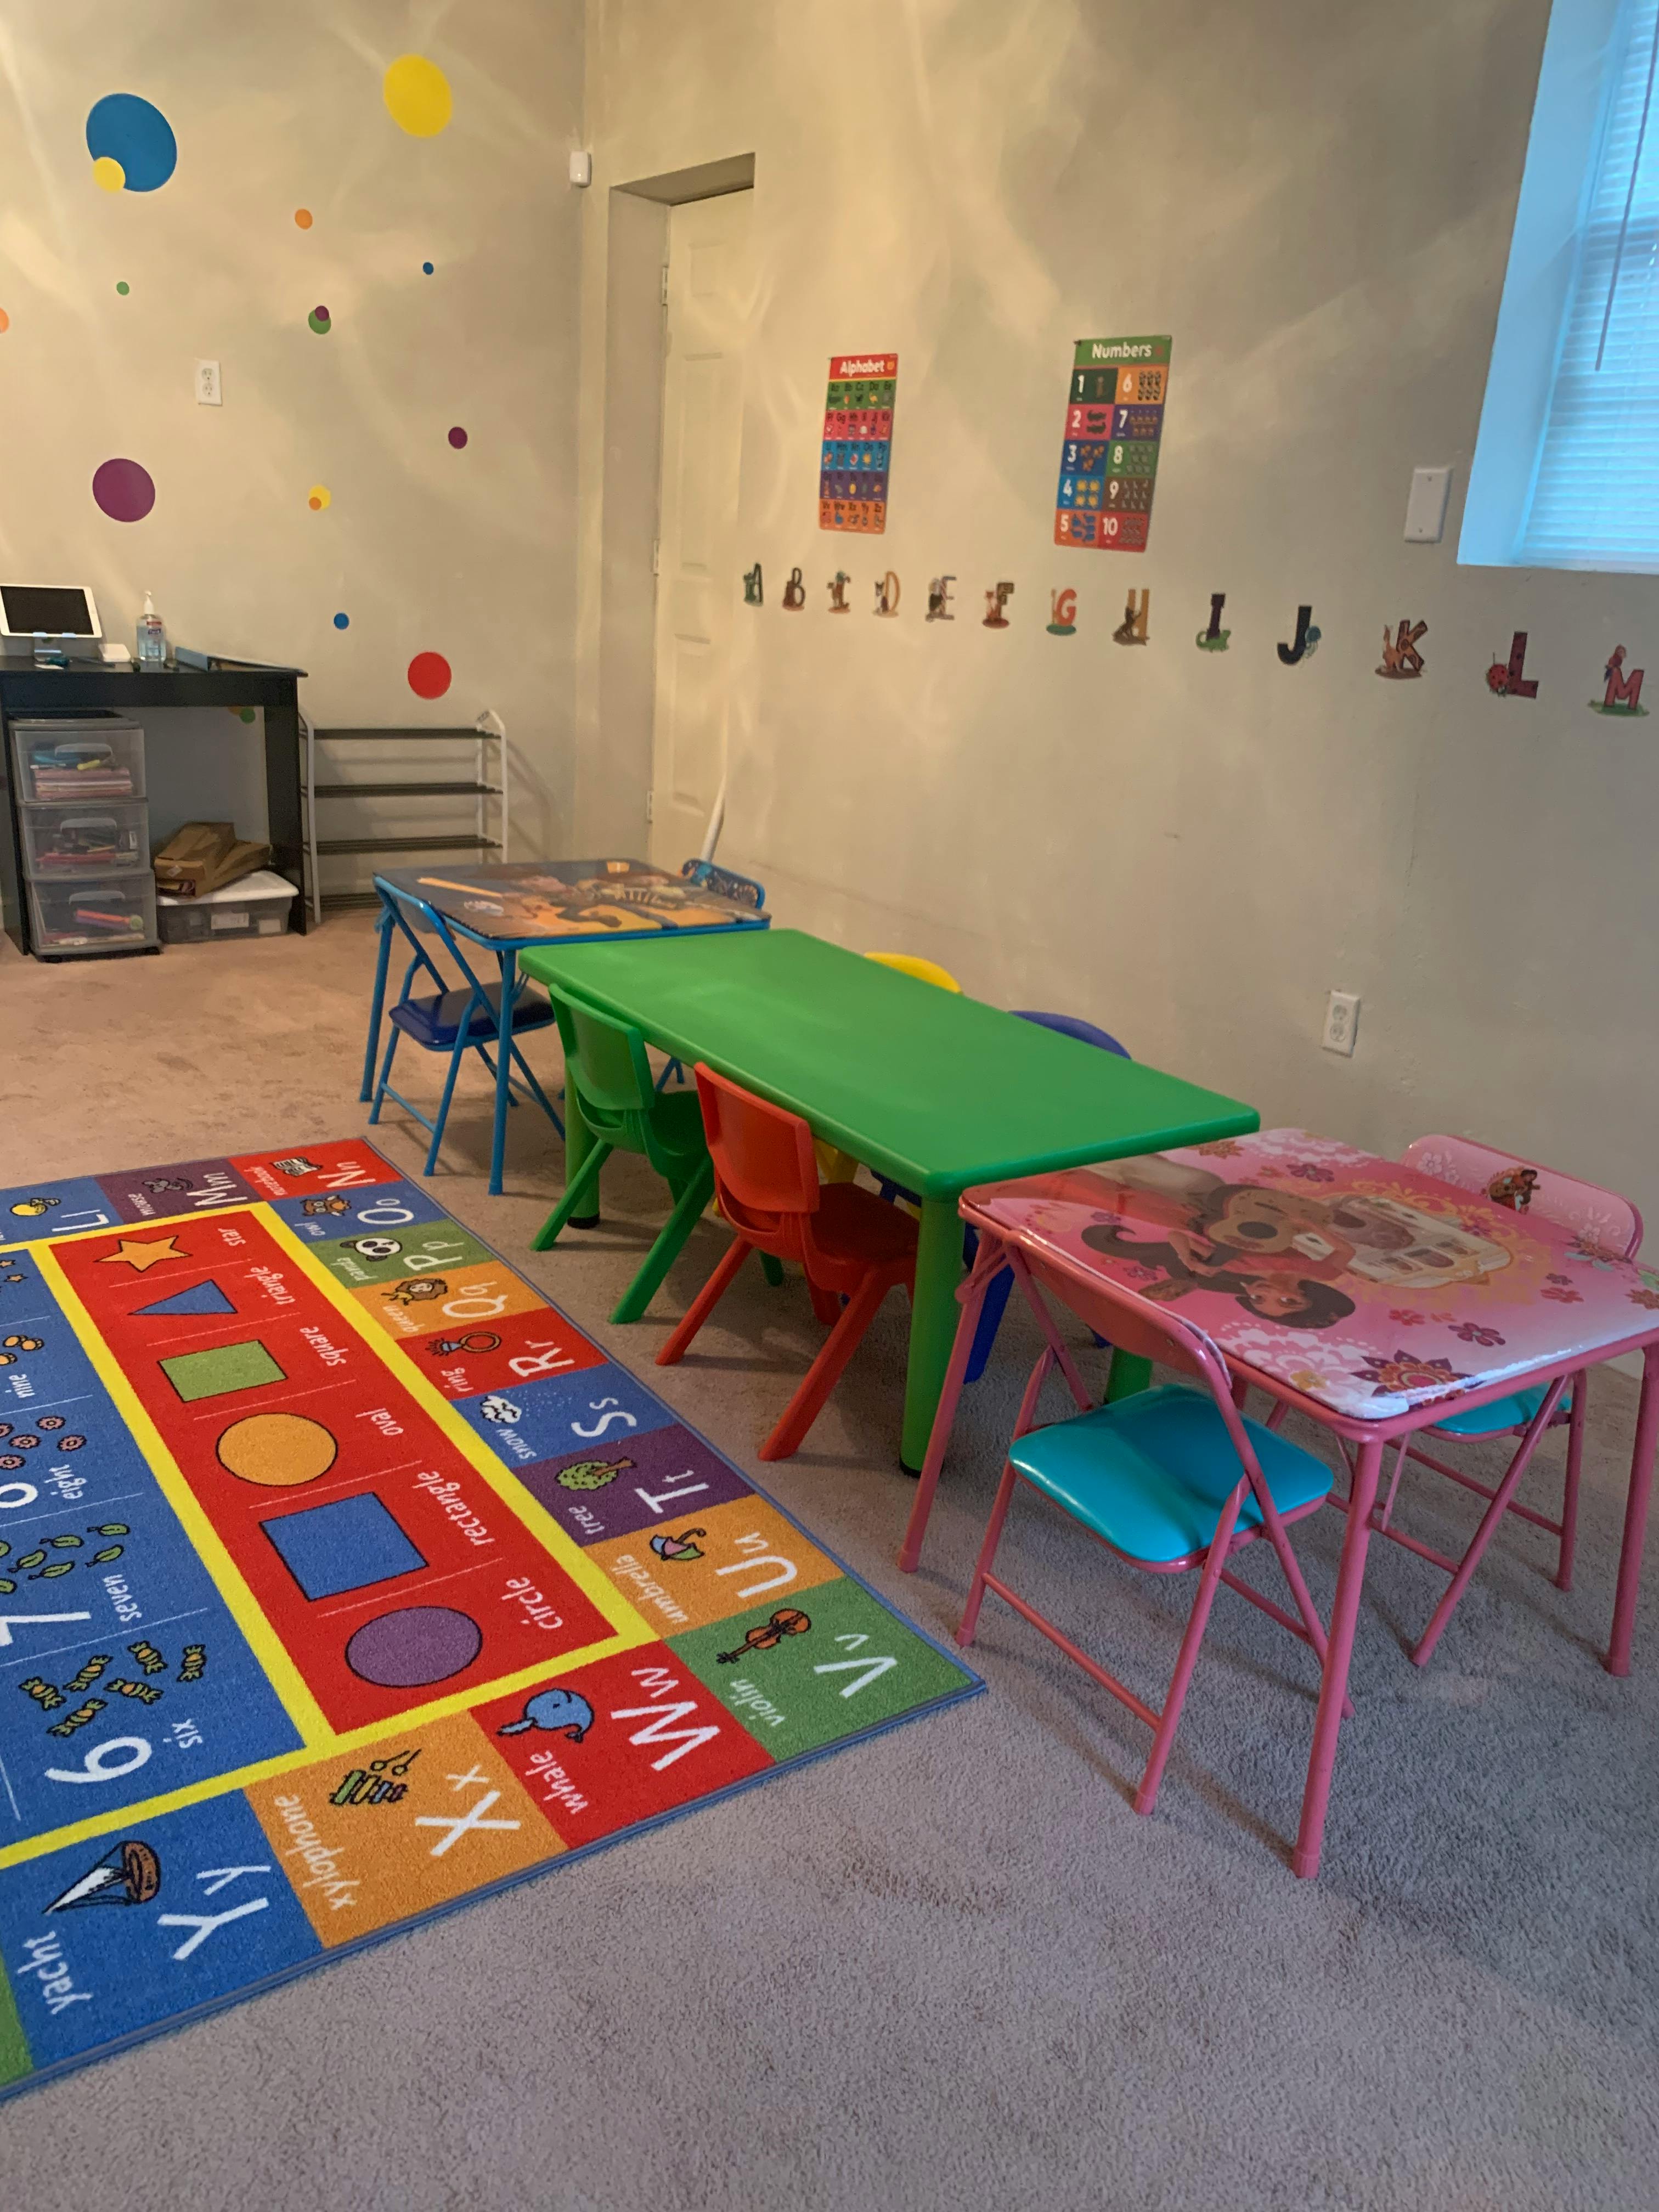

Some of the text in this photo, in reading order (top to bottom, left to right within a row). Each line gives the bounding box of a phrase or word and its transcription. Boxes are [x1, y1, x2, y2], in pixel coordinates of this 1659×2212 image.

[1092, 343, 1152, 359] Numbers
[839, 359, 884, 377] Alphabet
[1078, 375, 1084, 393] 1
[1123, 373, 1132, 393] 6
[1072, 410, 1081, 428] 2
[1119, 409, 1128, 428] 7
[1068, 444, 1077, 462] 3
[1114, 445, 1123, 464] 8
[1063, 479, 1073, 497] 4
[1110, 481, 1119, 499] 9
[1060, 514, 1069, 532] 5
[1103, 517, 1118, 535] 10
[745, 563, 763, 605] A
[785, 567, 805, 608] B
[885, 571, 901, 613] D
[1055, 588, 1077, 626] G
[1277, 605, 1312, 665] J
[1396, 619, 1428, 672] K
[1506, 631, 1539, 699] L
[1603, 666, 1645, 710] M
[242, 1167, 286, 1195] notebook
[128, 1194, 155, 1215] mouse
[218, 1228, 246, 1246] star
[295, 1222, 325, 1235] owl
[340, 1256, 379, 1282] panda
[250, 1266, 295, 1305] triangle
[382, 1304, 420, 1333] queen
[300, 1325, 347, 1367] square
[5, 1374, 35, 1397] nine
[441, 1368, 473, 1391] ring
[356, 1408, 403, 1435] oval
[496, 1429, 536, 1459] snow
[45, 1465, 86, 1499] eight
[414, 1471, 494, 1545] rectangle
[569, 1506, 604, 1534] tree
[103, 1575, 142, 1621] seven
[612, 1554, 689, 1624] umbrella
[502, 1578, 562, 1629] circle
[730, 1679, 785, 1726] violin
[163, 1719, 202, 1748] six
[45, 1737, 151, 1782] 6
[530, 1750, 588, 1815] whale
[274, 1795, 357, 1911] xylophone
[18, 1931, 92, 2014] yacht
